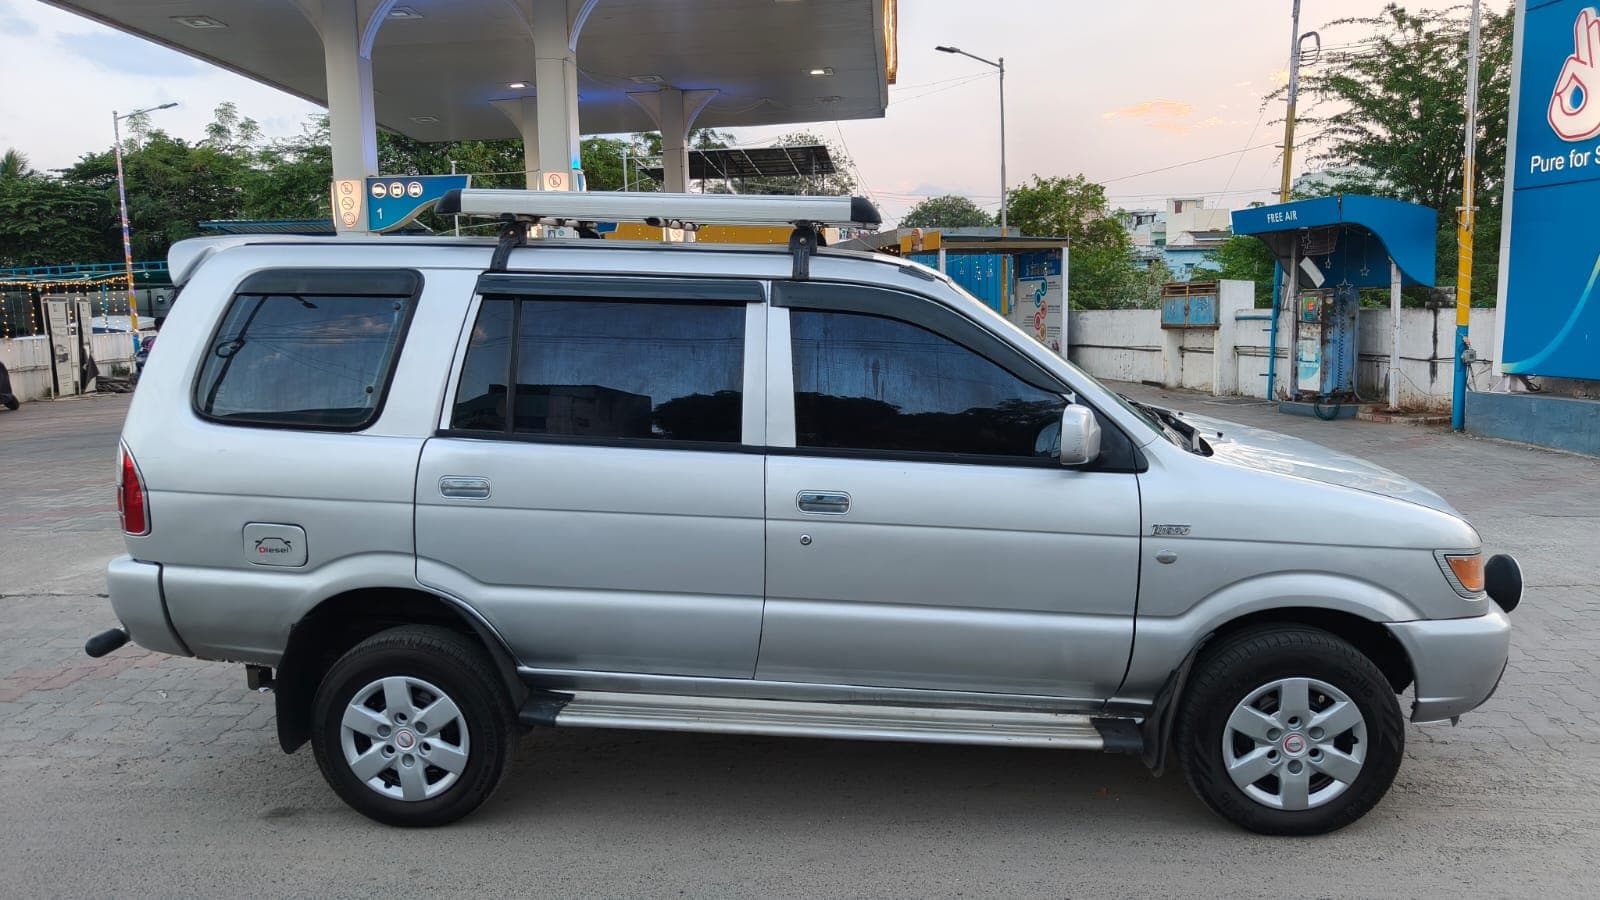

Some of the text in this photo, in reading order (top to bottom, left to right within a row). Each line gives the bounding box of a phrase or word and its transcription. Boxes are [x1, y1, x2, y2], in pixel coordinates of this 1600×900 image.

[1530, 155, 1565, 174] Pure
[1569, 149, 1591, 168] for
[376, 207, 383, 220] 1
[1267, 210, 1298, 224] FREE AIR
